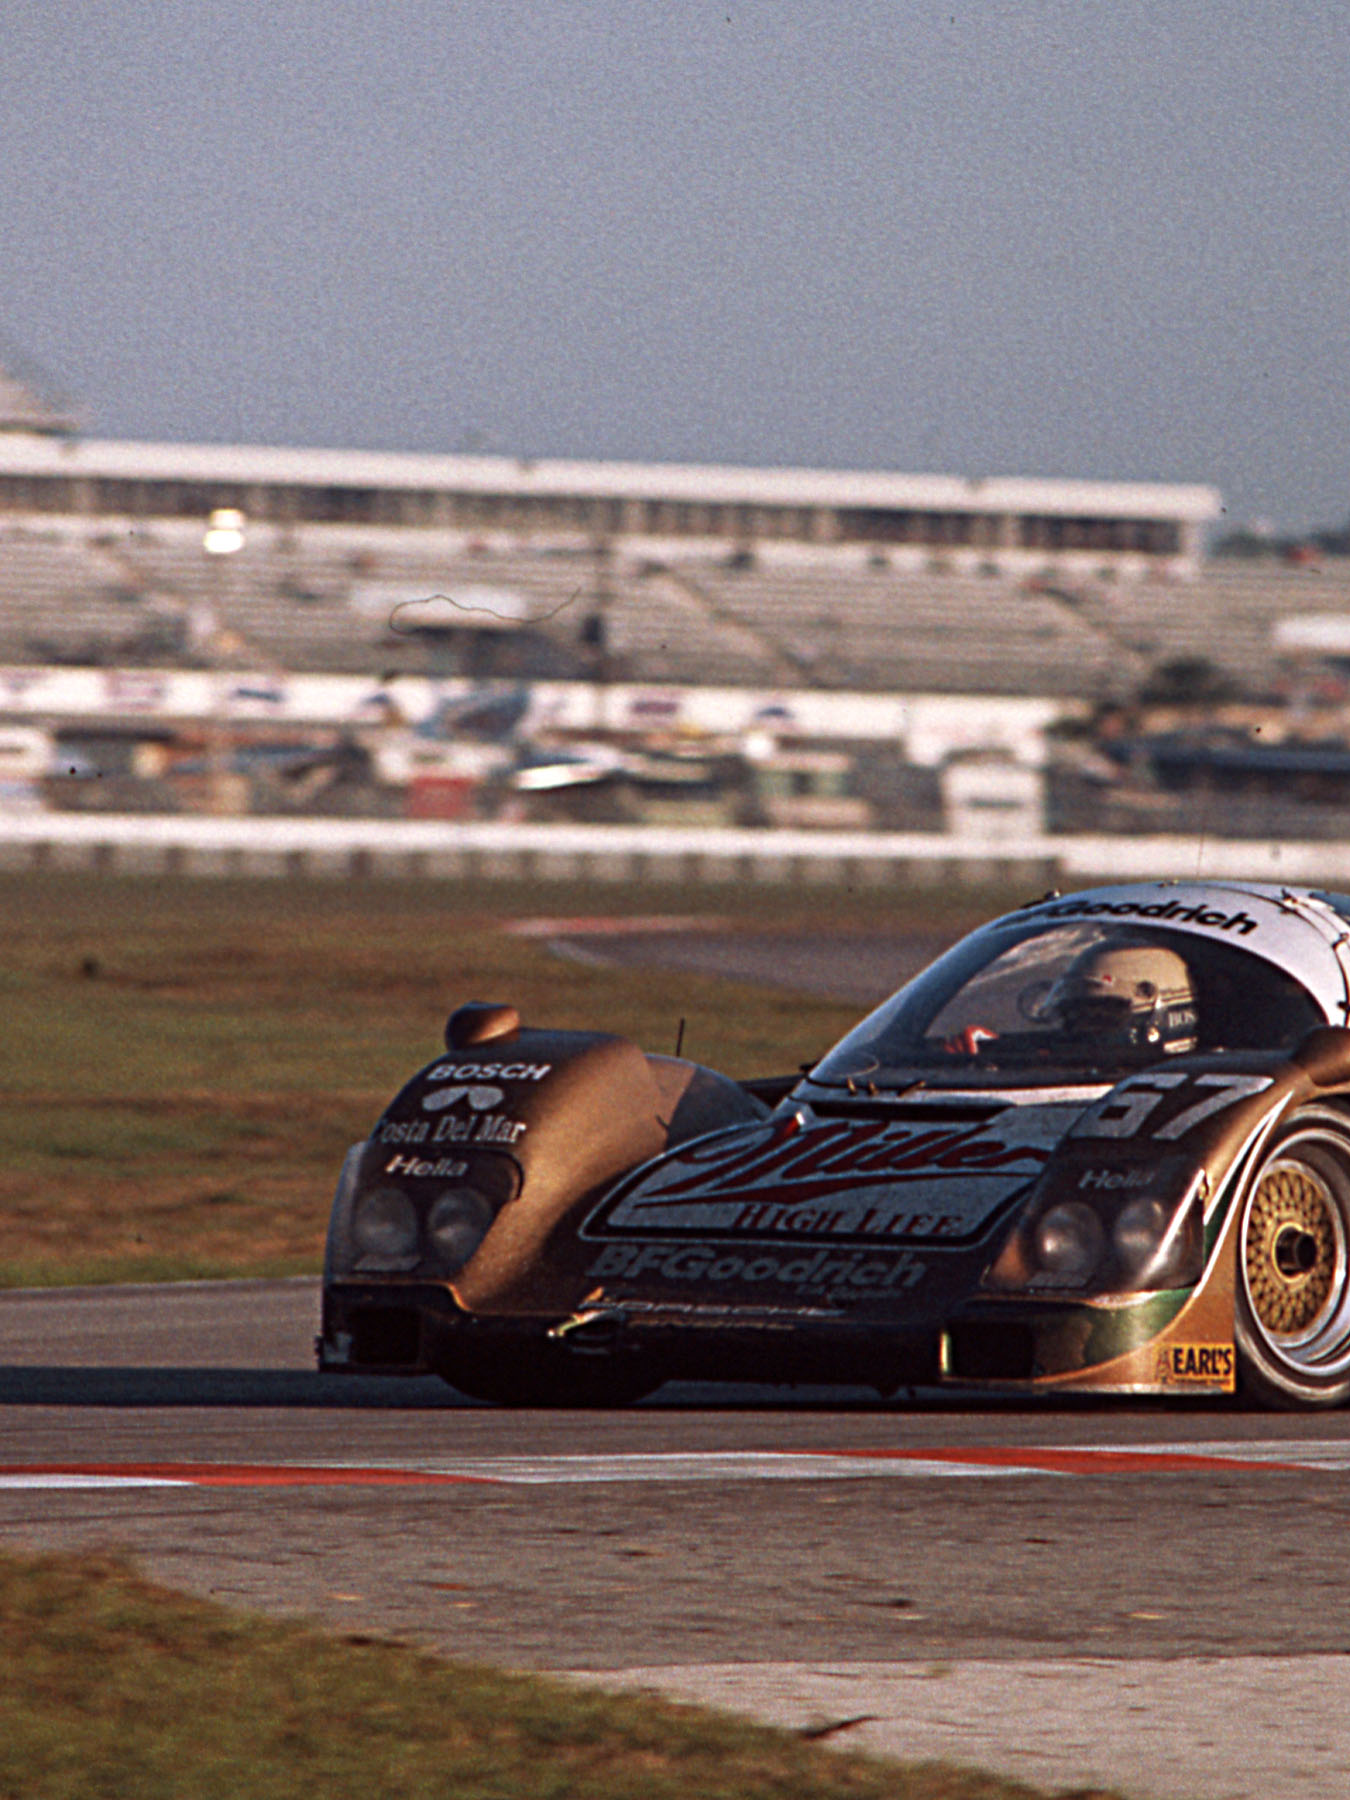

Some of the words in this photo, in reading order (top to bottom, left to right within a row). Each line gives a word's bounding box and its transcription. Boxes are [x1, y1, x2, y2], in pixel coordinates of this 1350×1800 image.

[427, 1063, 551, 1081] BOSCH
[1069, 1072, 1277, 1140] 67
[379, 1117, 431, 1145] osta
[432, 1114, 478, 1142] Del
[474, 1114, 528, 1144] Mar
[385, 1155, 469, 1177] Hella
[732, 1203, 846, 1232] HIGH
[854, 1207, 964, 1236] LIFE
[584, 1243, 927, 1288] BFGoodrich
[1173, 1346, 1233, 1375] EARL'S
